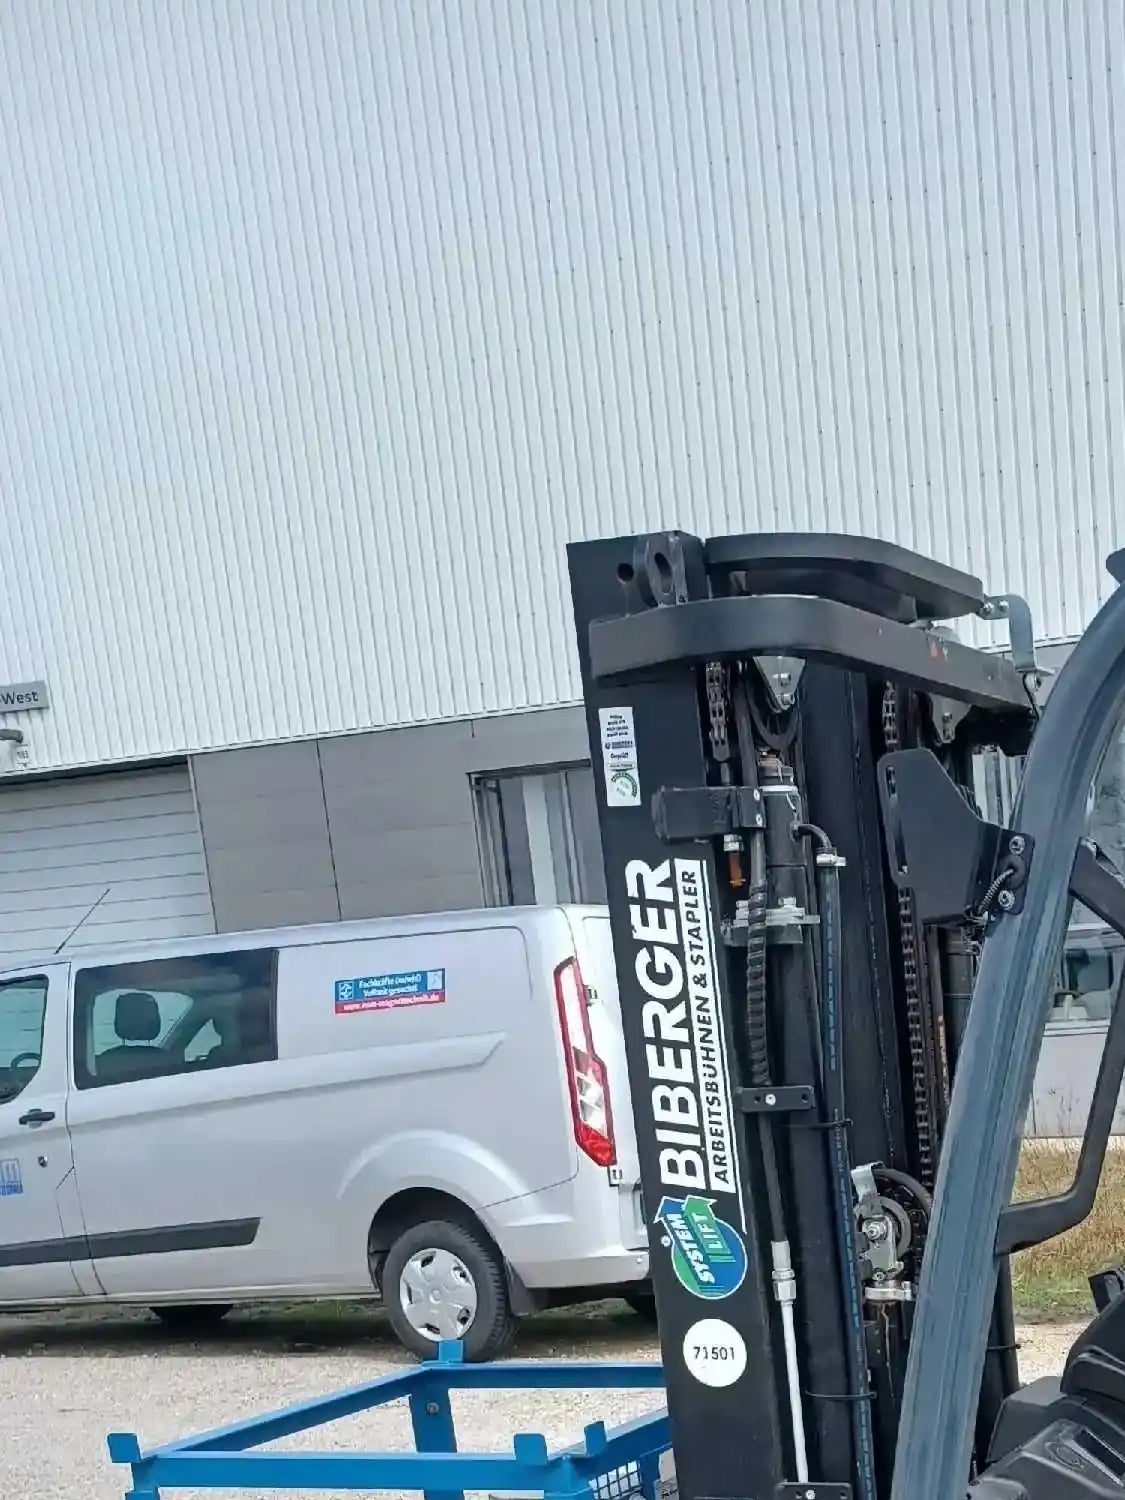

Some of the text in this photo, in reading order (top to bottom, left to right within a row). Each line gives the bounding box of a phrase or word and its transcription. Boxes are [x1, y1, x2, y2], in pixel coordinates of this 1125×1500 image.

[625, 859, 706, 1189] BIBERGER
[682, 870, 729, 1184] ARBEITSBÜHNEN & STAPLER
[666, 1213, 715, 1285] SYSTEM
[693, 1212, 724, 1249] LIFT
[693, 1346, 735, 1361] 71501
